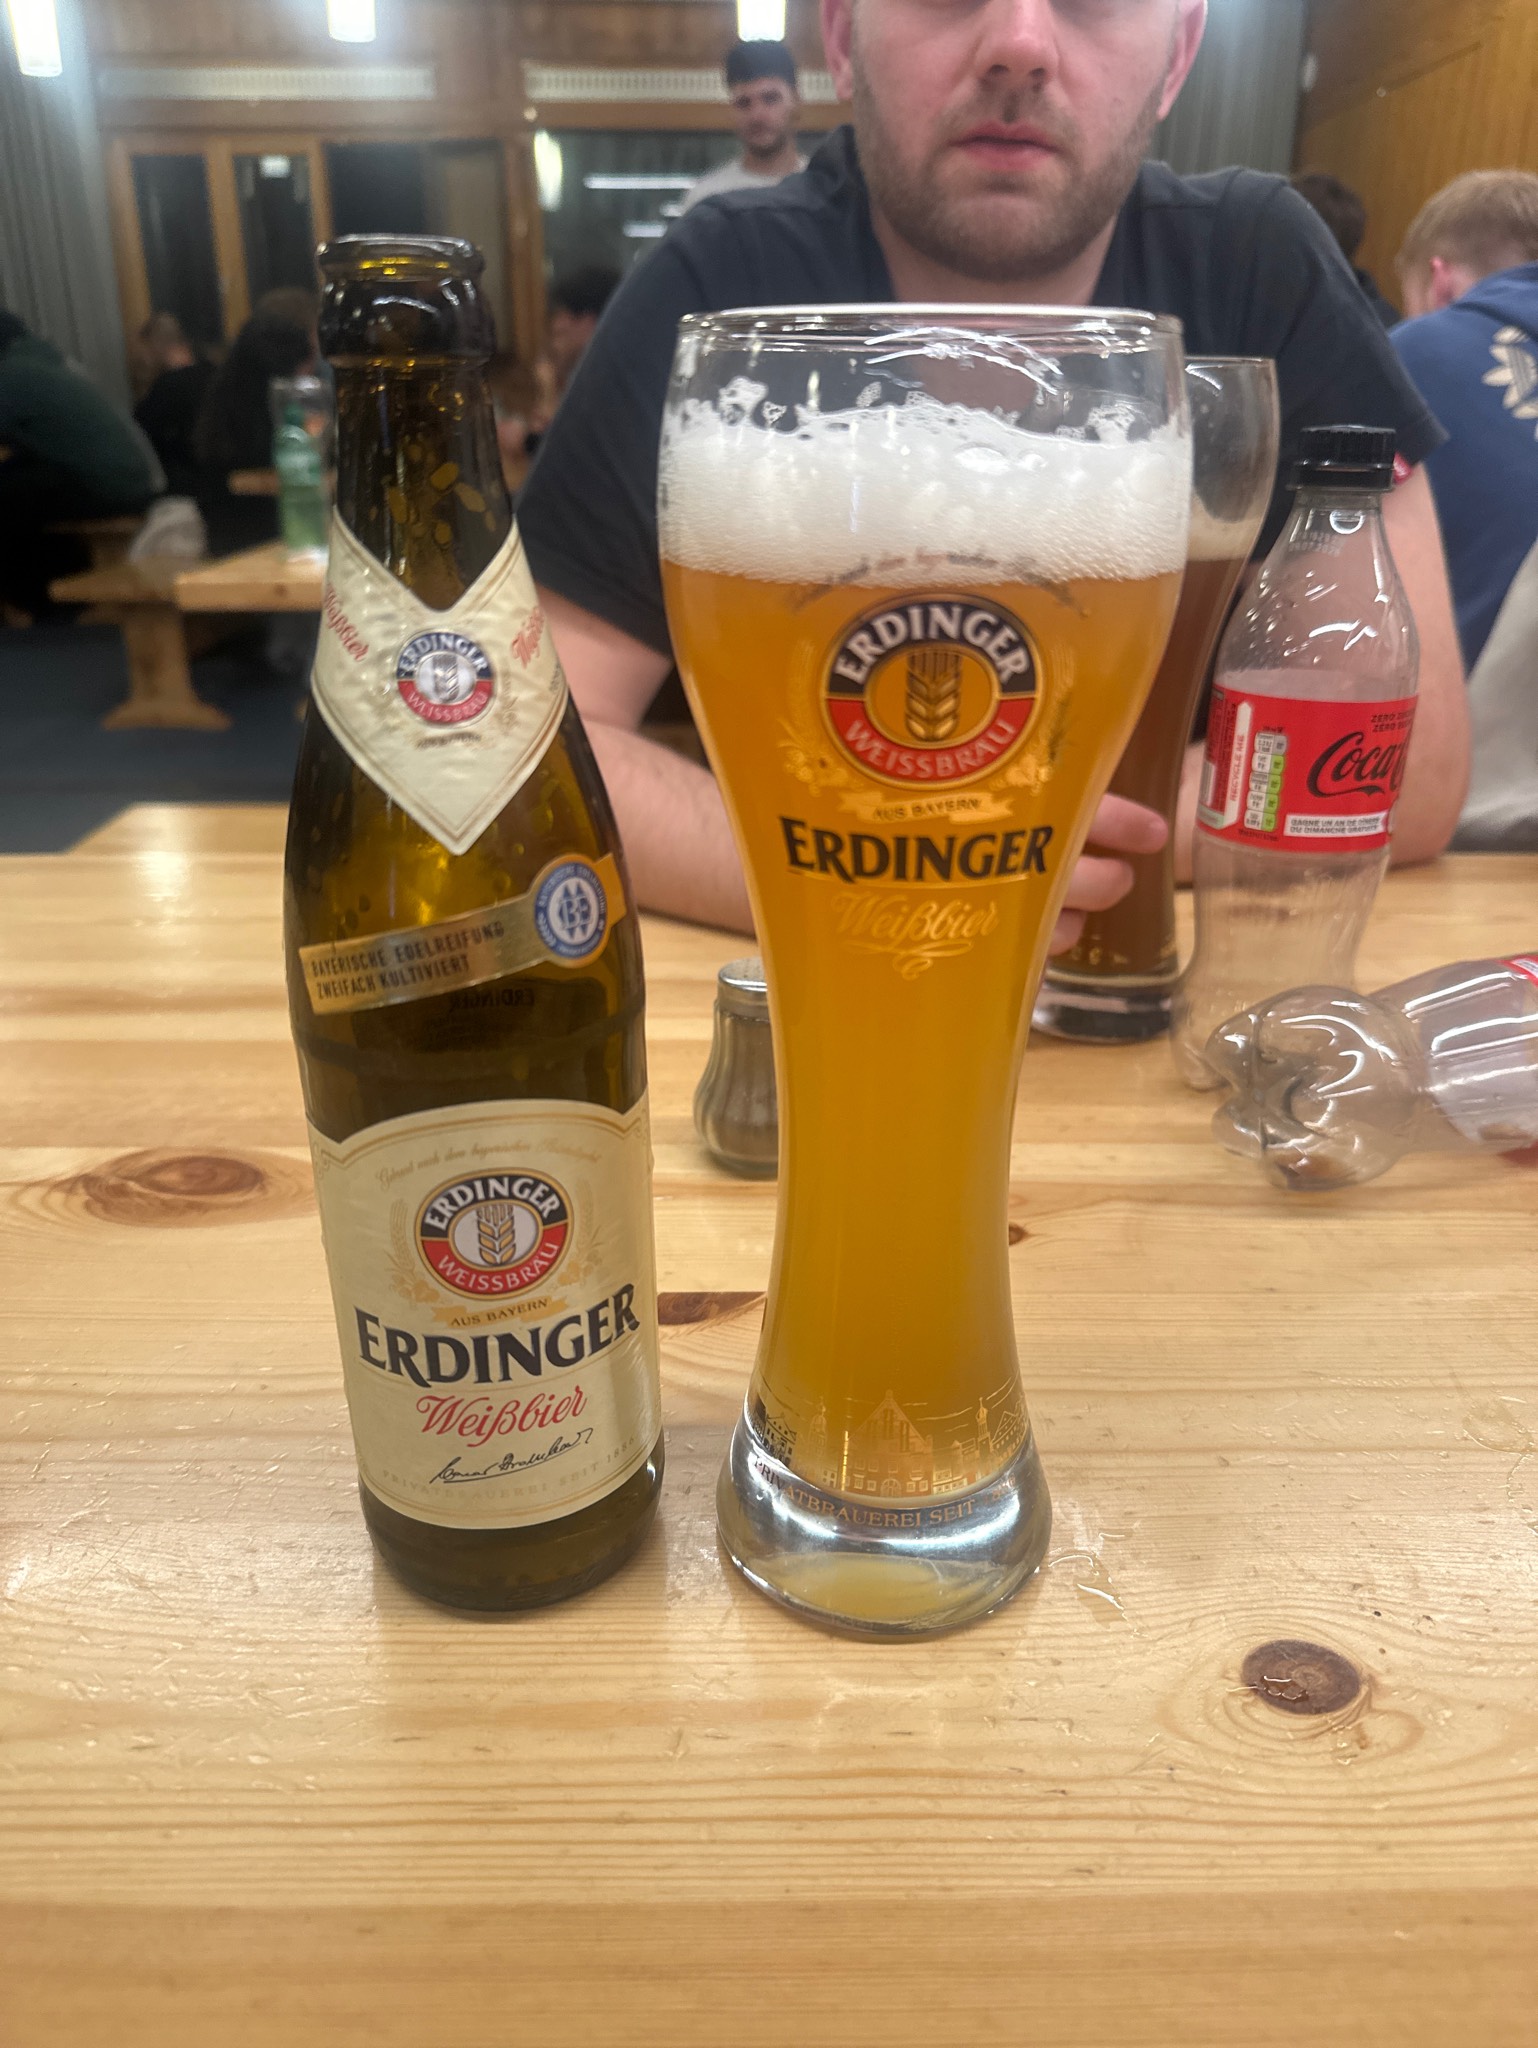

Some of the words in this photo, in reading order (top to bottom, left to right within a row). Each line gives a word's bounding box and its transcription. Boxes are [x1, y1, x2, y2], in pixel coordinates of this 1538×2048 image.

[834, 604, 1030, 686] ERDINGER
[779, 816, 1054, 884] ERDINGER
[311, 951, 386, 978] BAYERISCHE
[396, 921, 504, 963] EDELREIFUNG
[317, 976, 376, 1000] ZWEIFACH
[380, 954, 470, 988] KULTIVIERT
[425, 1176, 561, 1232] ERDINGER
[438, 1242, 559, 1293] WEISSBRÄU
[354, 1283, 641, 1388] ERDINGER
[451, 1316, 481, 1328] AUS
[487, 1299, 549, 1322] BAYERN
[416, 1385, 588, 1448] Weißbier
[754, 1457, 922, 1529] PRIVATBRAUEREI
[929, 1499, 975, 1525] SEIT
